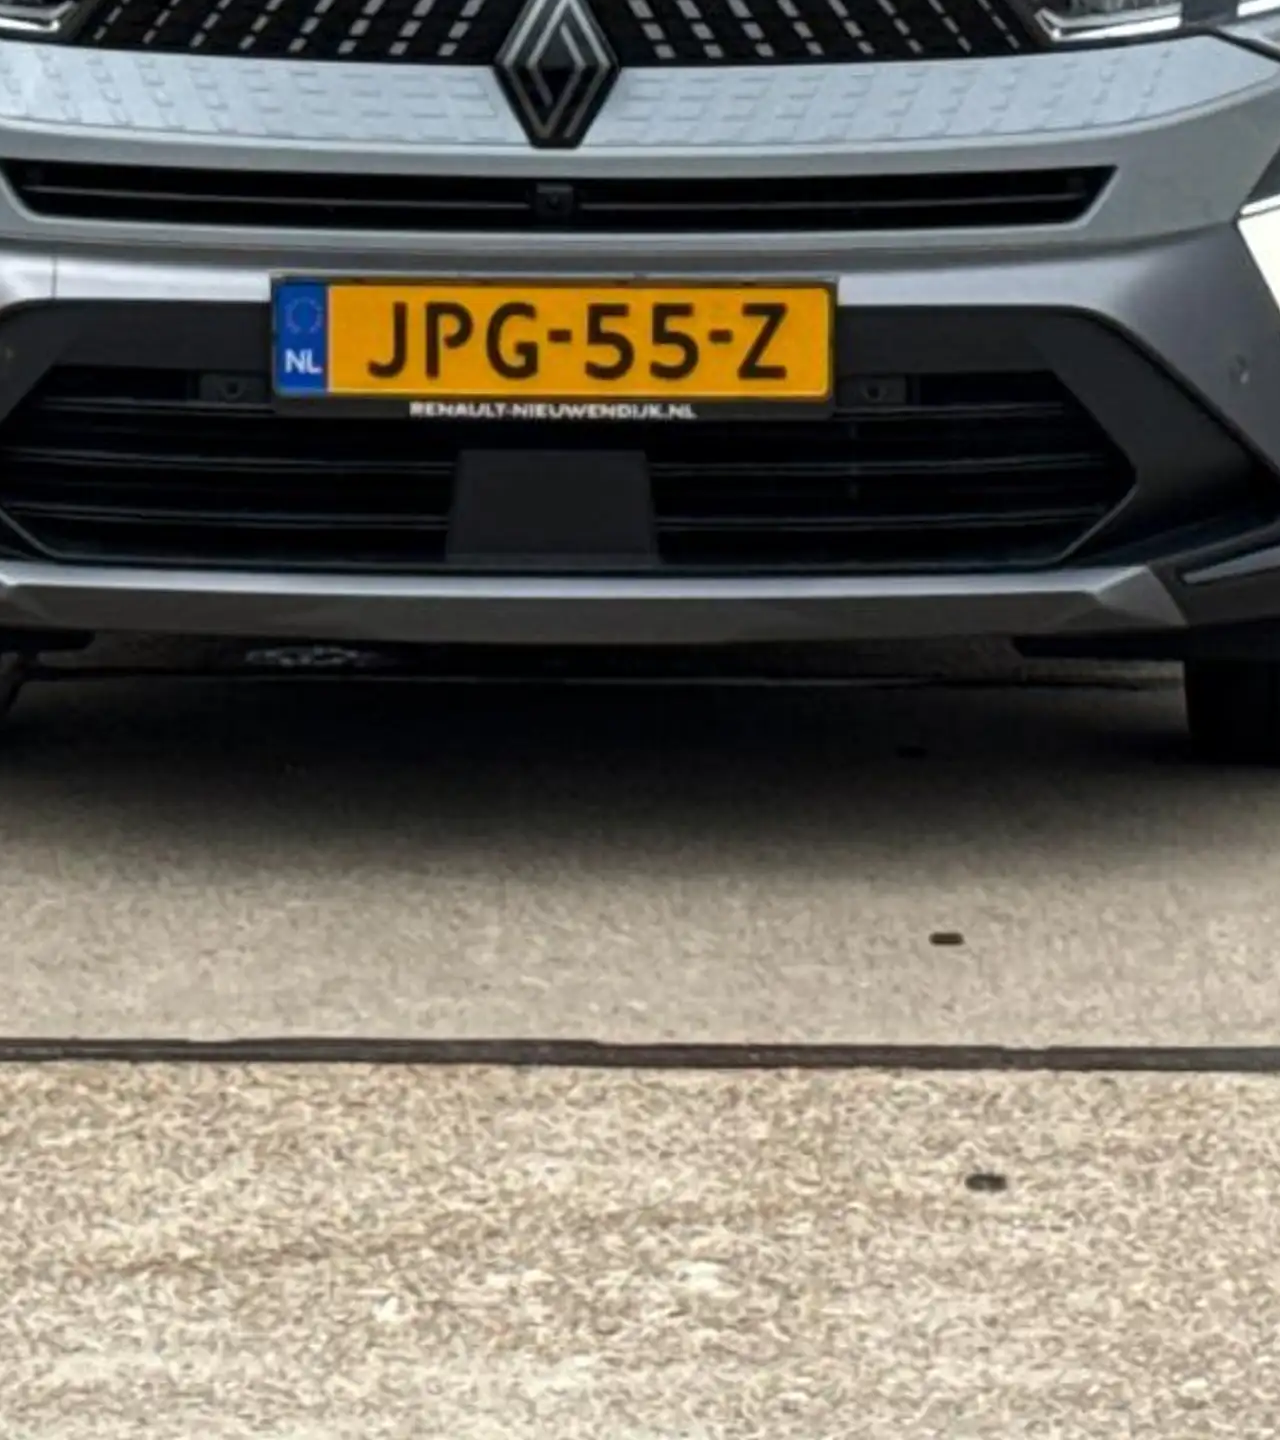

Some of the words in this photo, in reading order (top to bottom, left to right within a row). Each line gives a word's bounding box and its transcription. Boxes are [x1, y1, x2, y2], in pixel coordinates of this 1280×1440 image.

[367, 301, 789, 381] JPG-55-Z
[284, 348, 321, 374] NL
[409, 401, 697, 419] RENAULT-NIEUWENDIJK.NL
